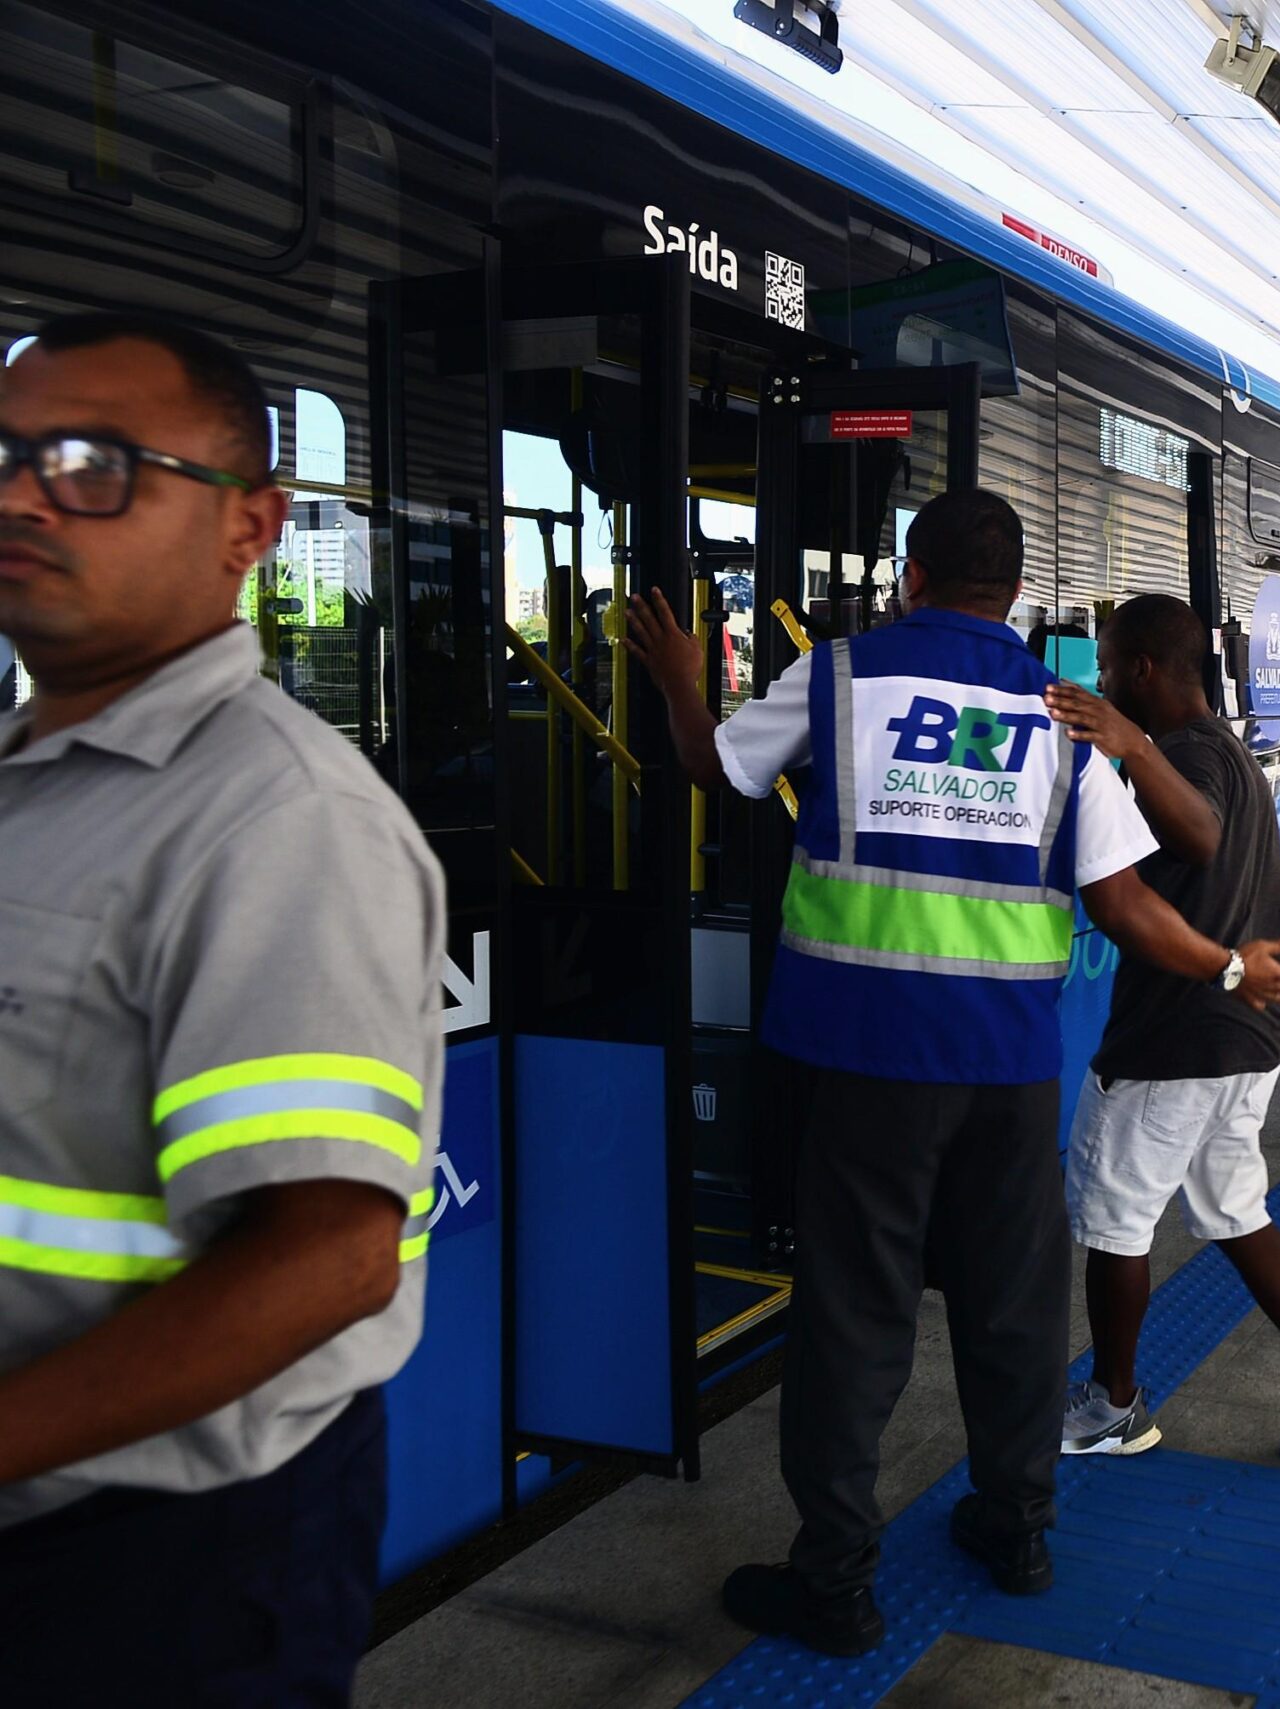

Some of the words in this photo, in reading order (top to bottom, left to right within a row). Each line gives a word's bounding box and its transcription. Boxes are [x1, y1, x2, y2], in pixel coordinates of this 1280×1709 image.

[643, 205, 738, 290] Saída
[886, 695, 1051, 773] BRT
[868, 799, 941, 820] SUPORTE
[883, 768, 1018, 804] SALVADOR
